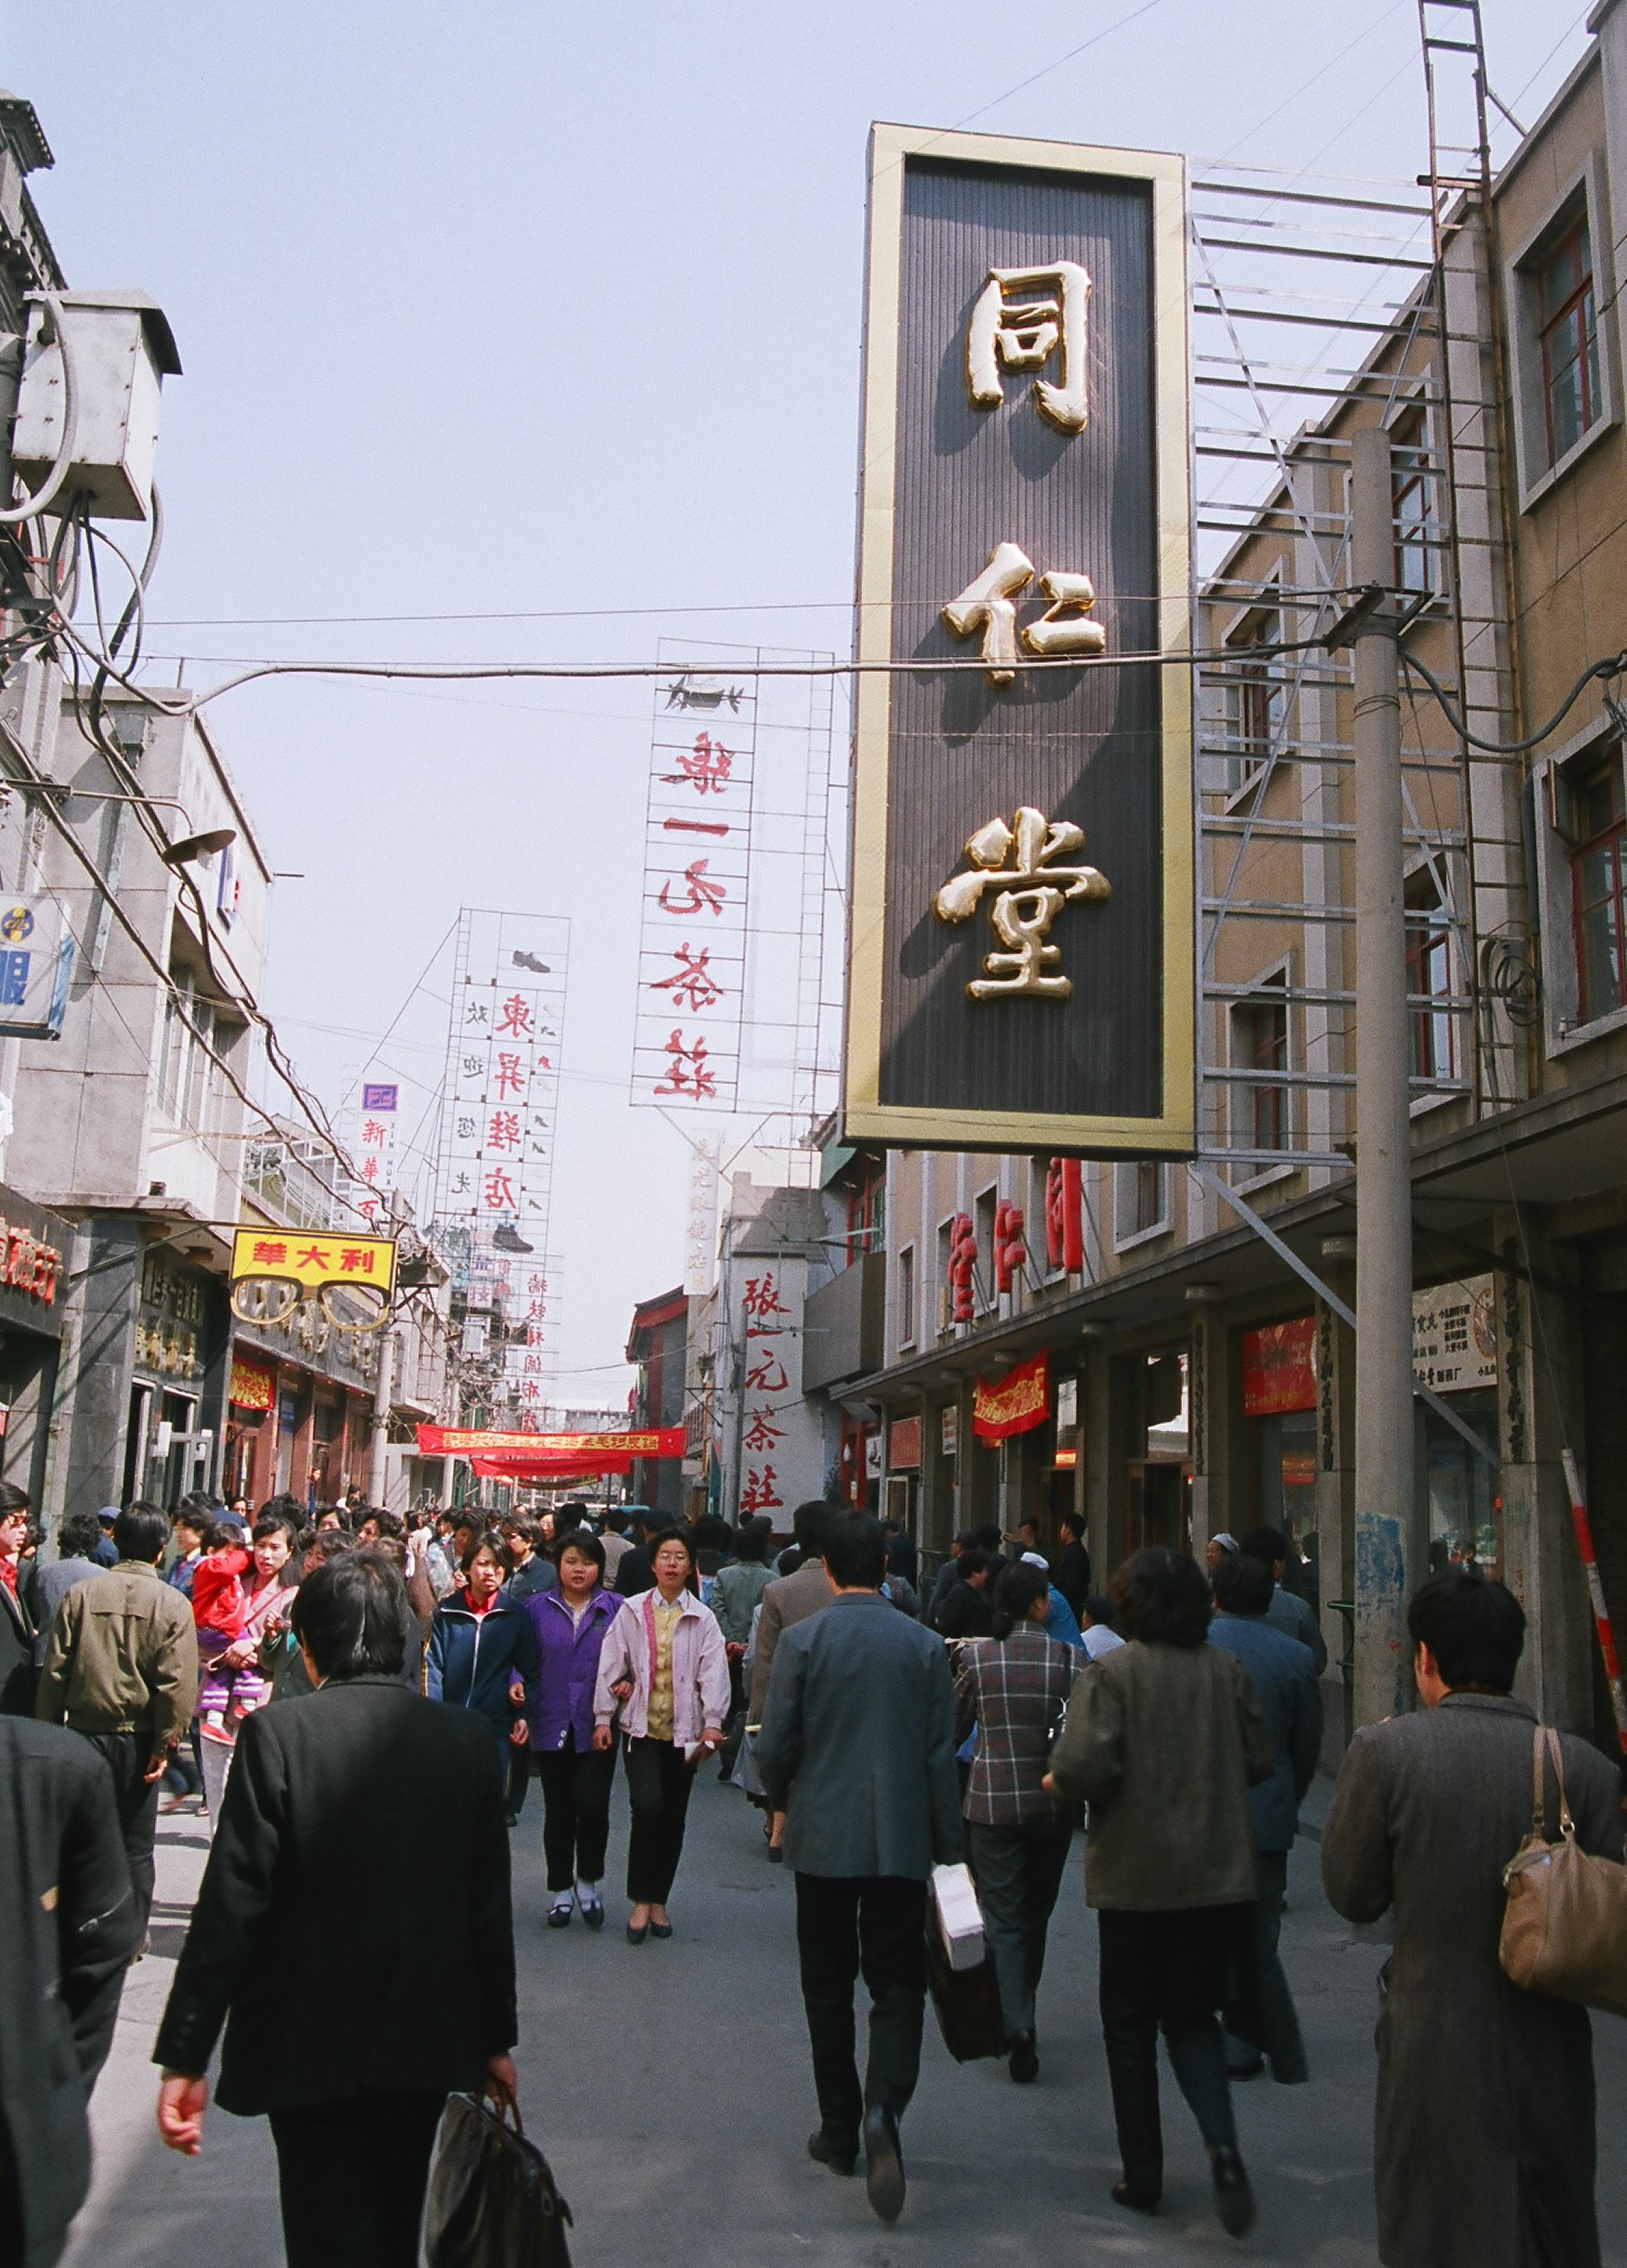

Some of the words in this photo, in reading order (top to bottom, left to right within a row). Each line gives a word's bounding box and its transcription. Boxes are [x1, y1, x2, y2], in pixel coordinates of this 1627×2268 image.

[931, 259, 1111, 1004] 同仁堂
[252, 1241, 375, 1273] 華大利
